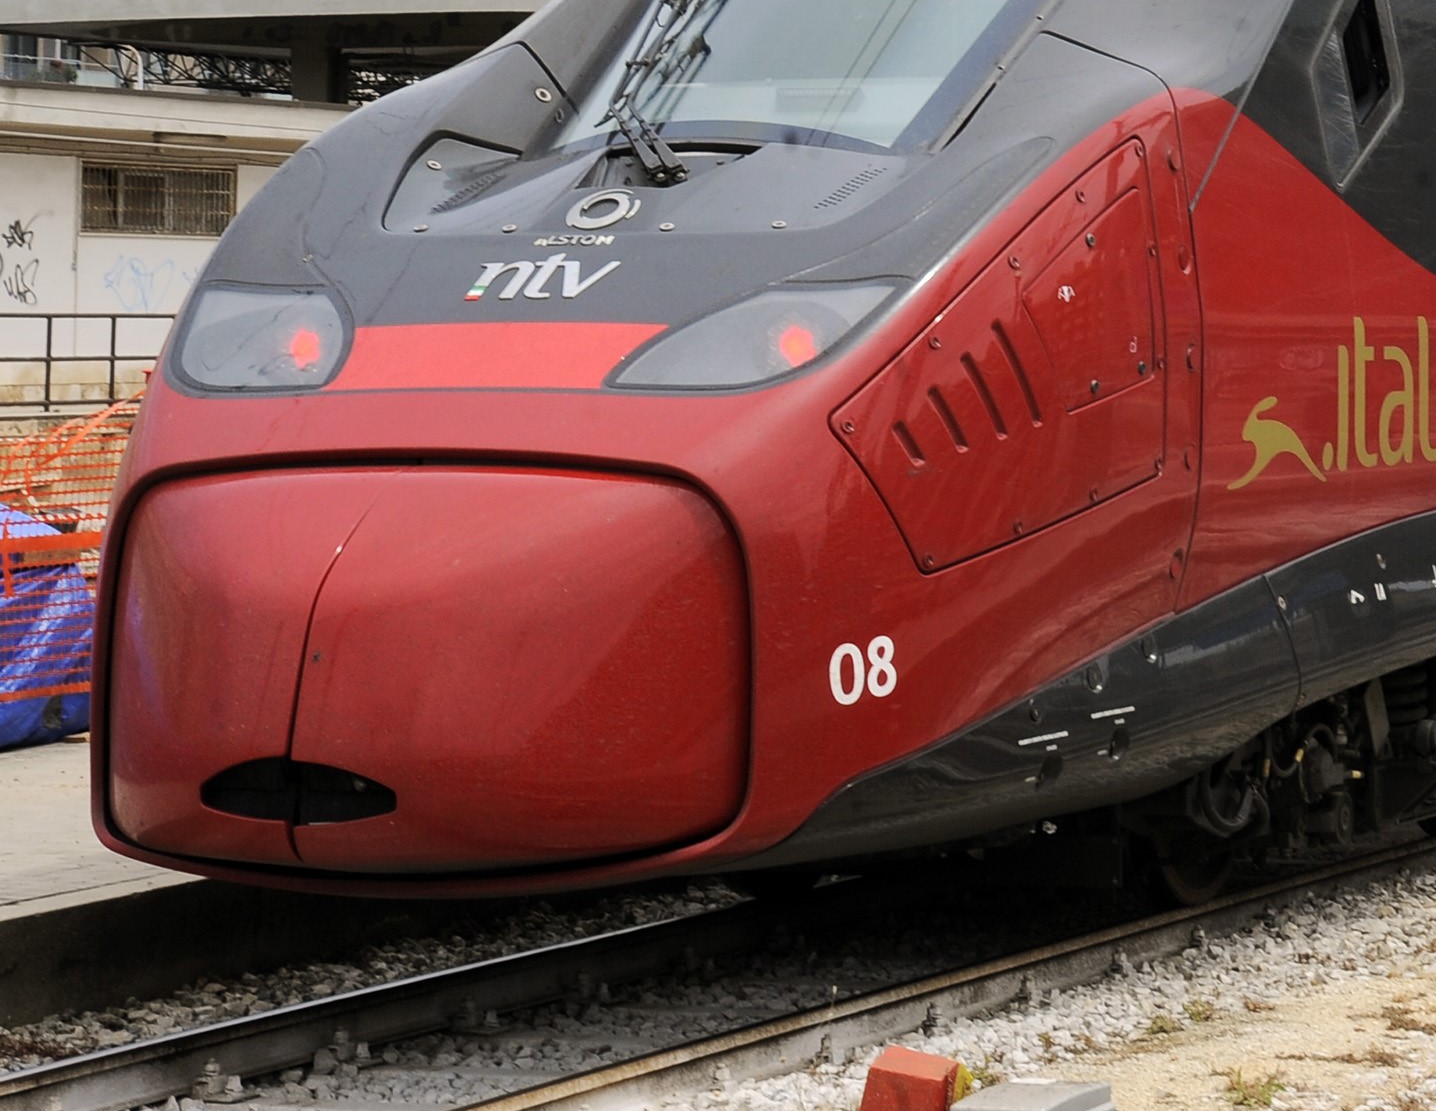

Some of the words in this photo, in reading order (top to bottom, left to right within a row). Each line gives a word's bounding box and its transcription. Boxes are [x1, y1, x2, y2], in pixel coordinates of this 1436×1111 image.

[533, 234, 615, 247] ALSTOM
[464, 252, 621, 301] ntv
[829, 635, 897, 706] 08
